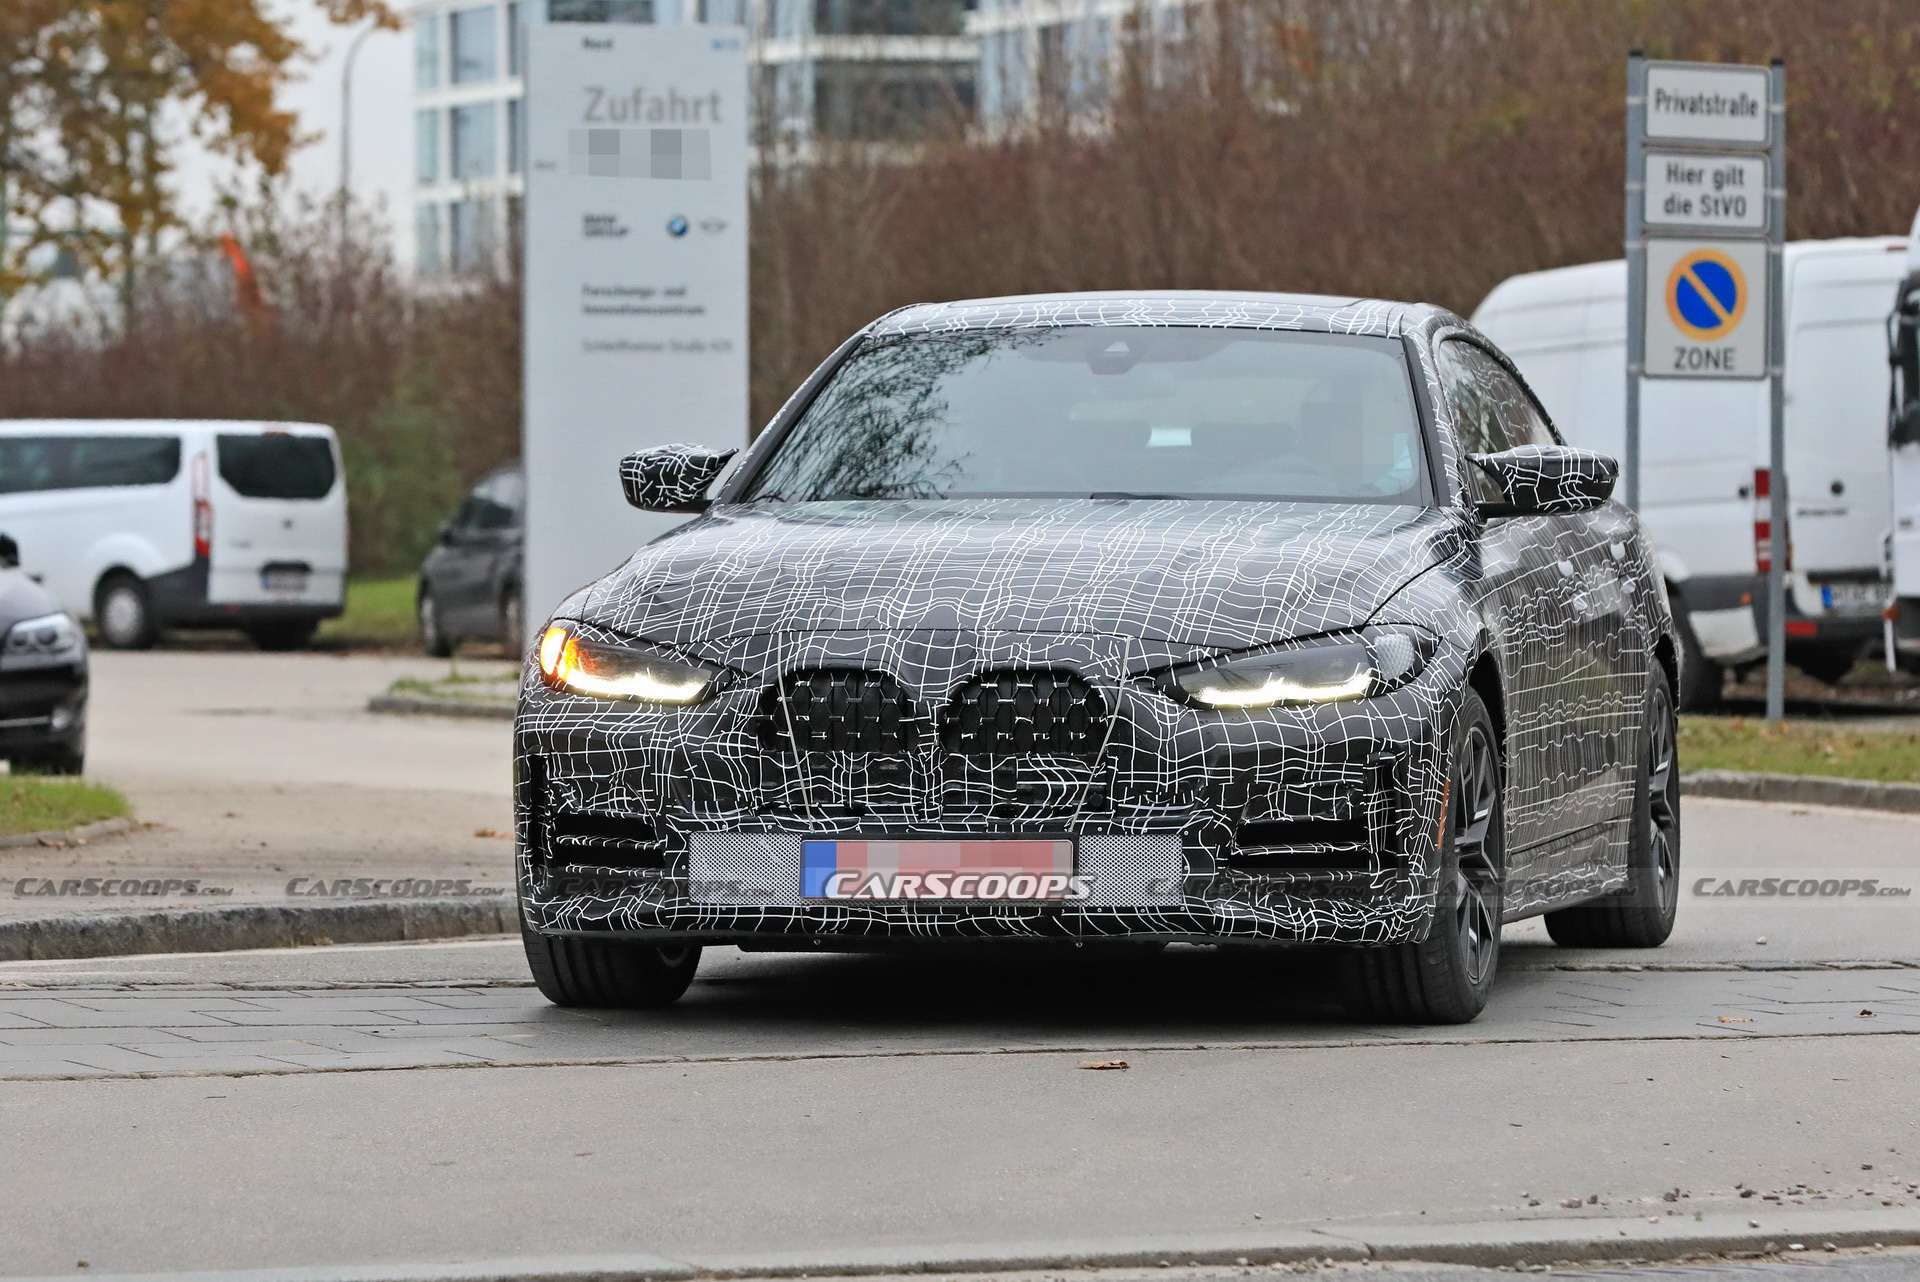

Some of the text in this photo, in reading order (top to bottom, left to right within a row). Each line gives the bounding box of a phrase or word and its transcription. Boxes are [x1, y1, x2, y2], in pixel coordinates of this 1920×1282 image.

[583, 86, 721, 123] Zufahrt
[1655, 88, 1759, 118] Privatstraße
[1666, 163, 1745, 191] Hier gilt
[1664, 194, 1748, 219] die StVO
[1674, 346, 1736, 371] ZONE
